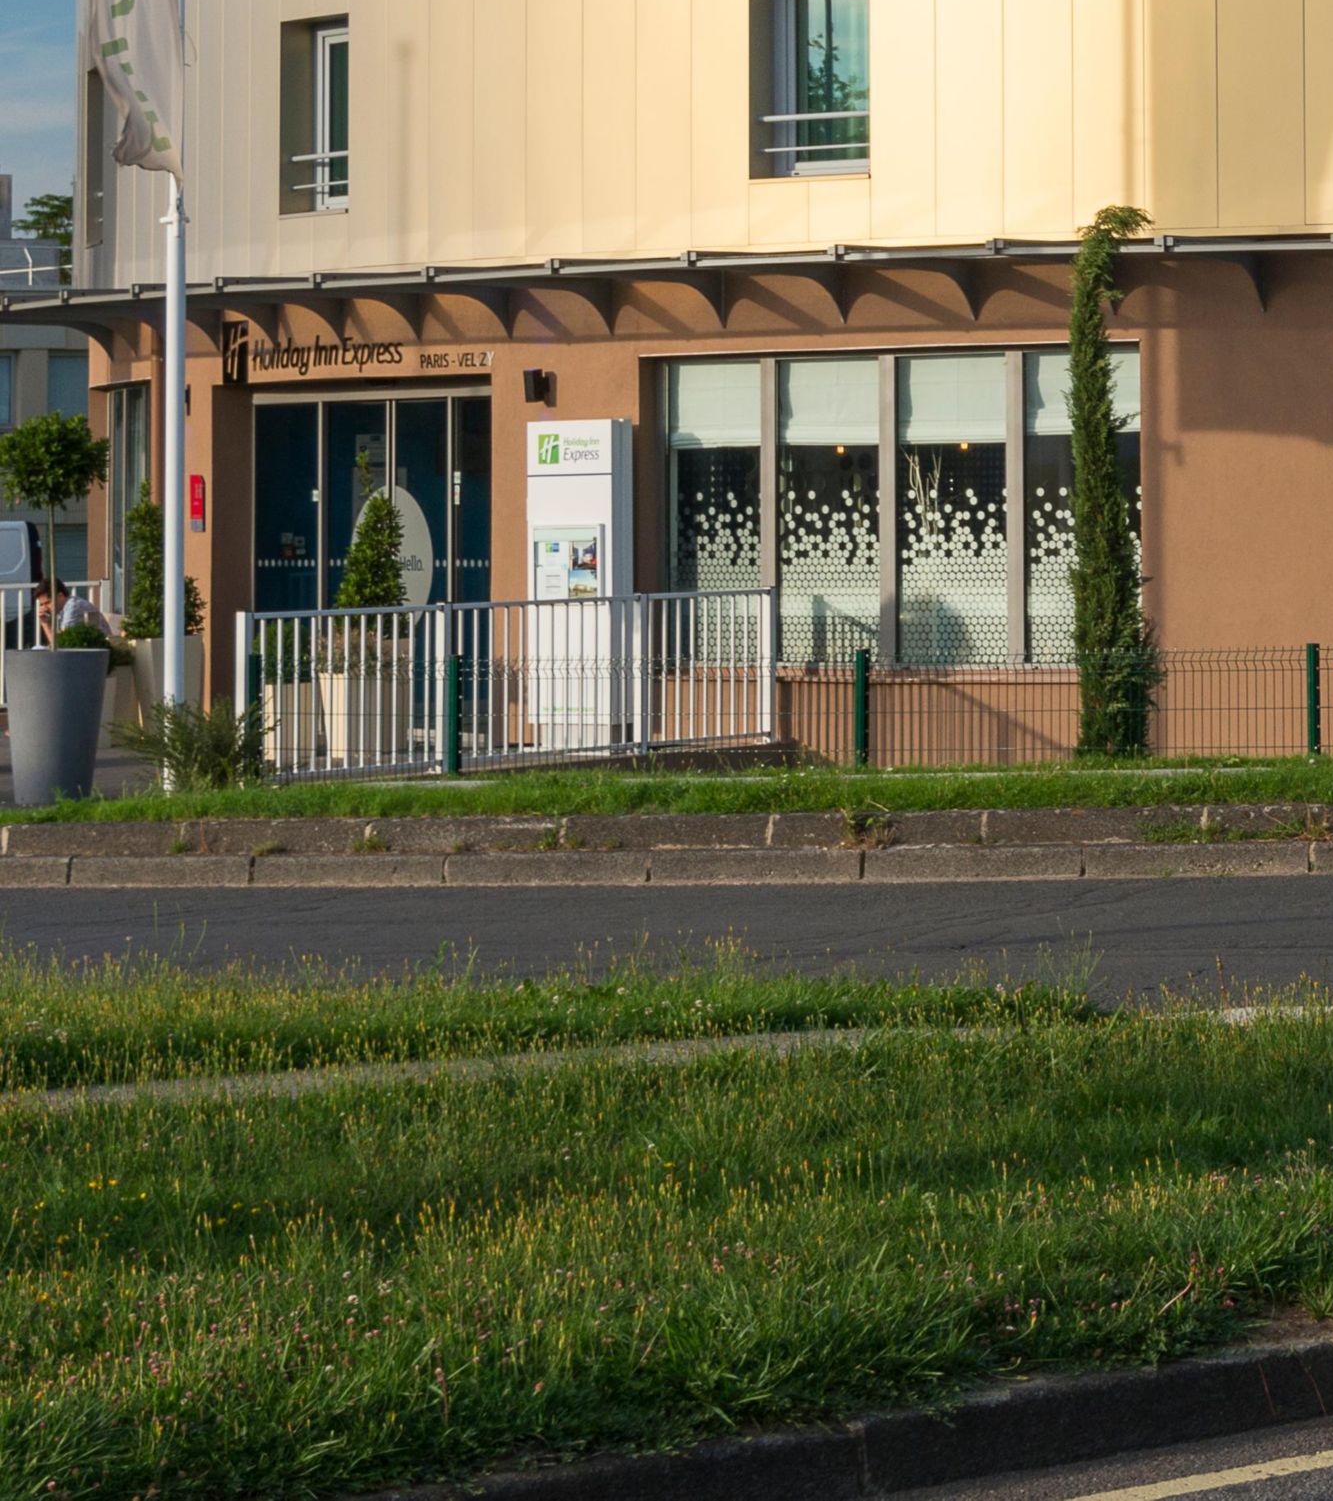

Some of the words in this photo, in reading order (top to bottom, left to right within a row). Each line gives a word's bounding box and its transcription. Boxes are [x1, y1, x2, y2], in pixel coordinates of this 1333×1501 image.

[252, 338, 311, 376] Holiday
[312, 334, 338, 367] Inn
[341, 336, 403, 373] Express
[420, 353, 449, 369] PARIS
[563, 447, 600, 464] Express
